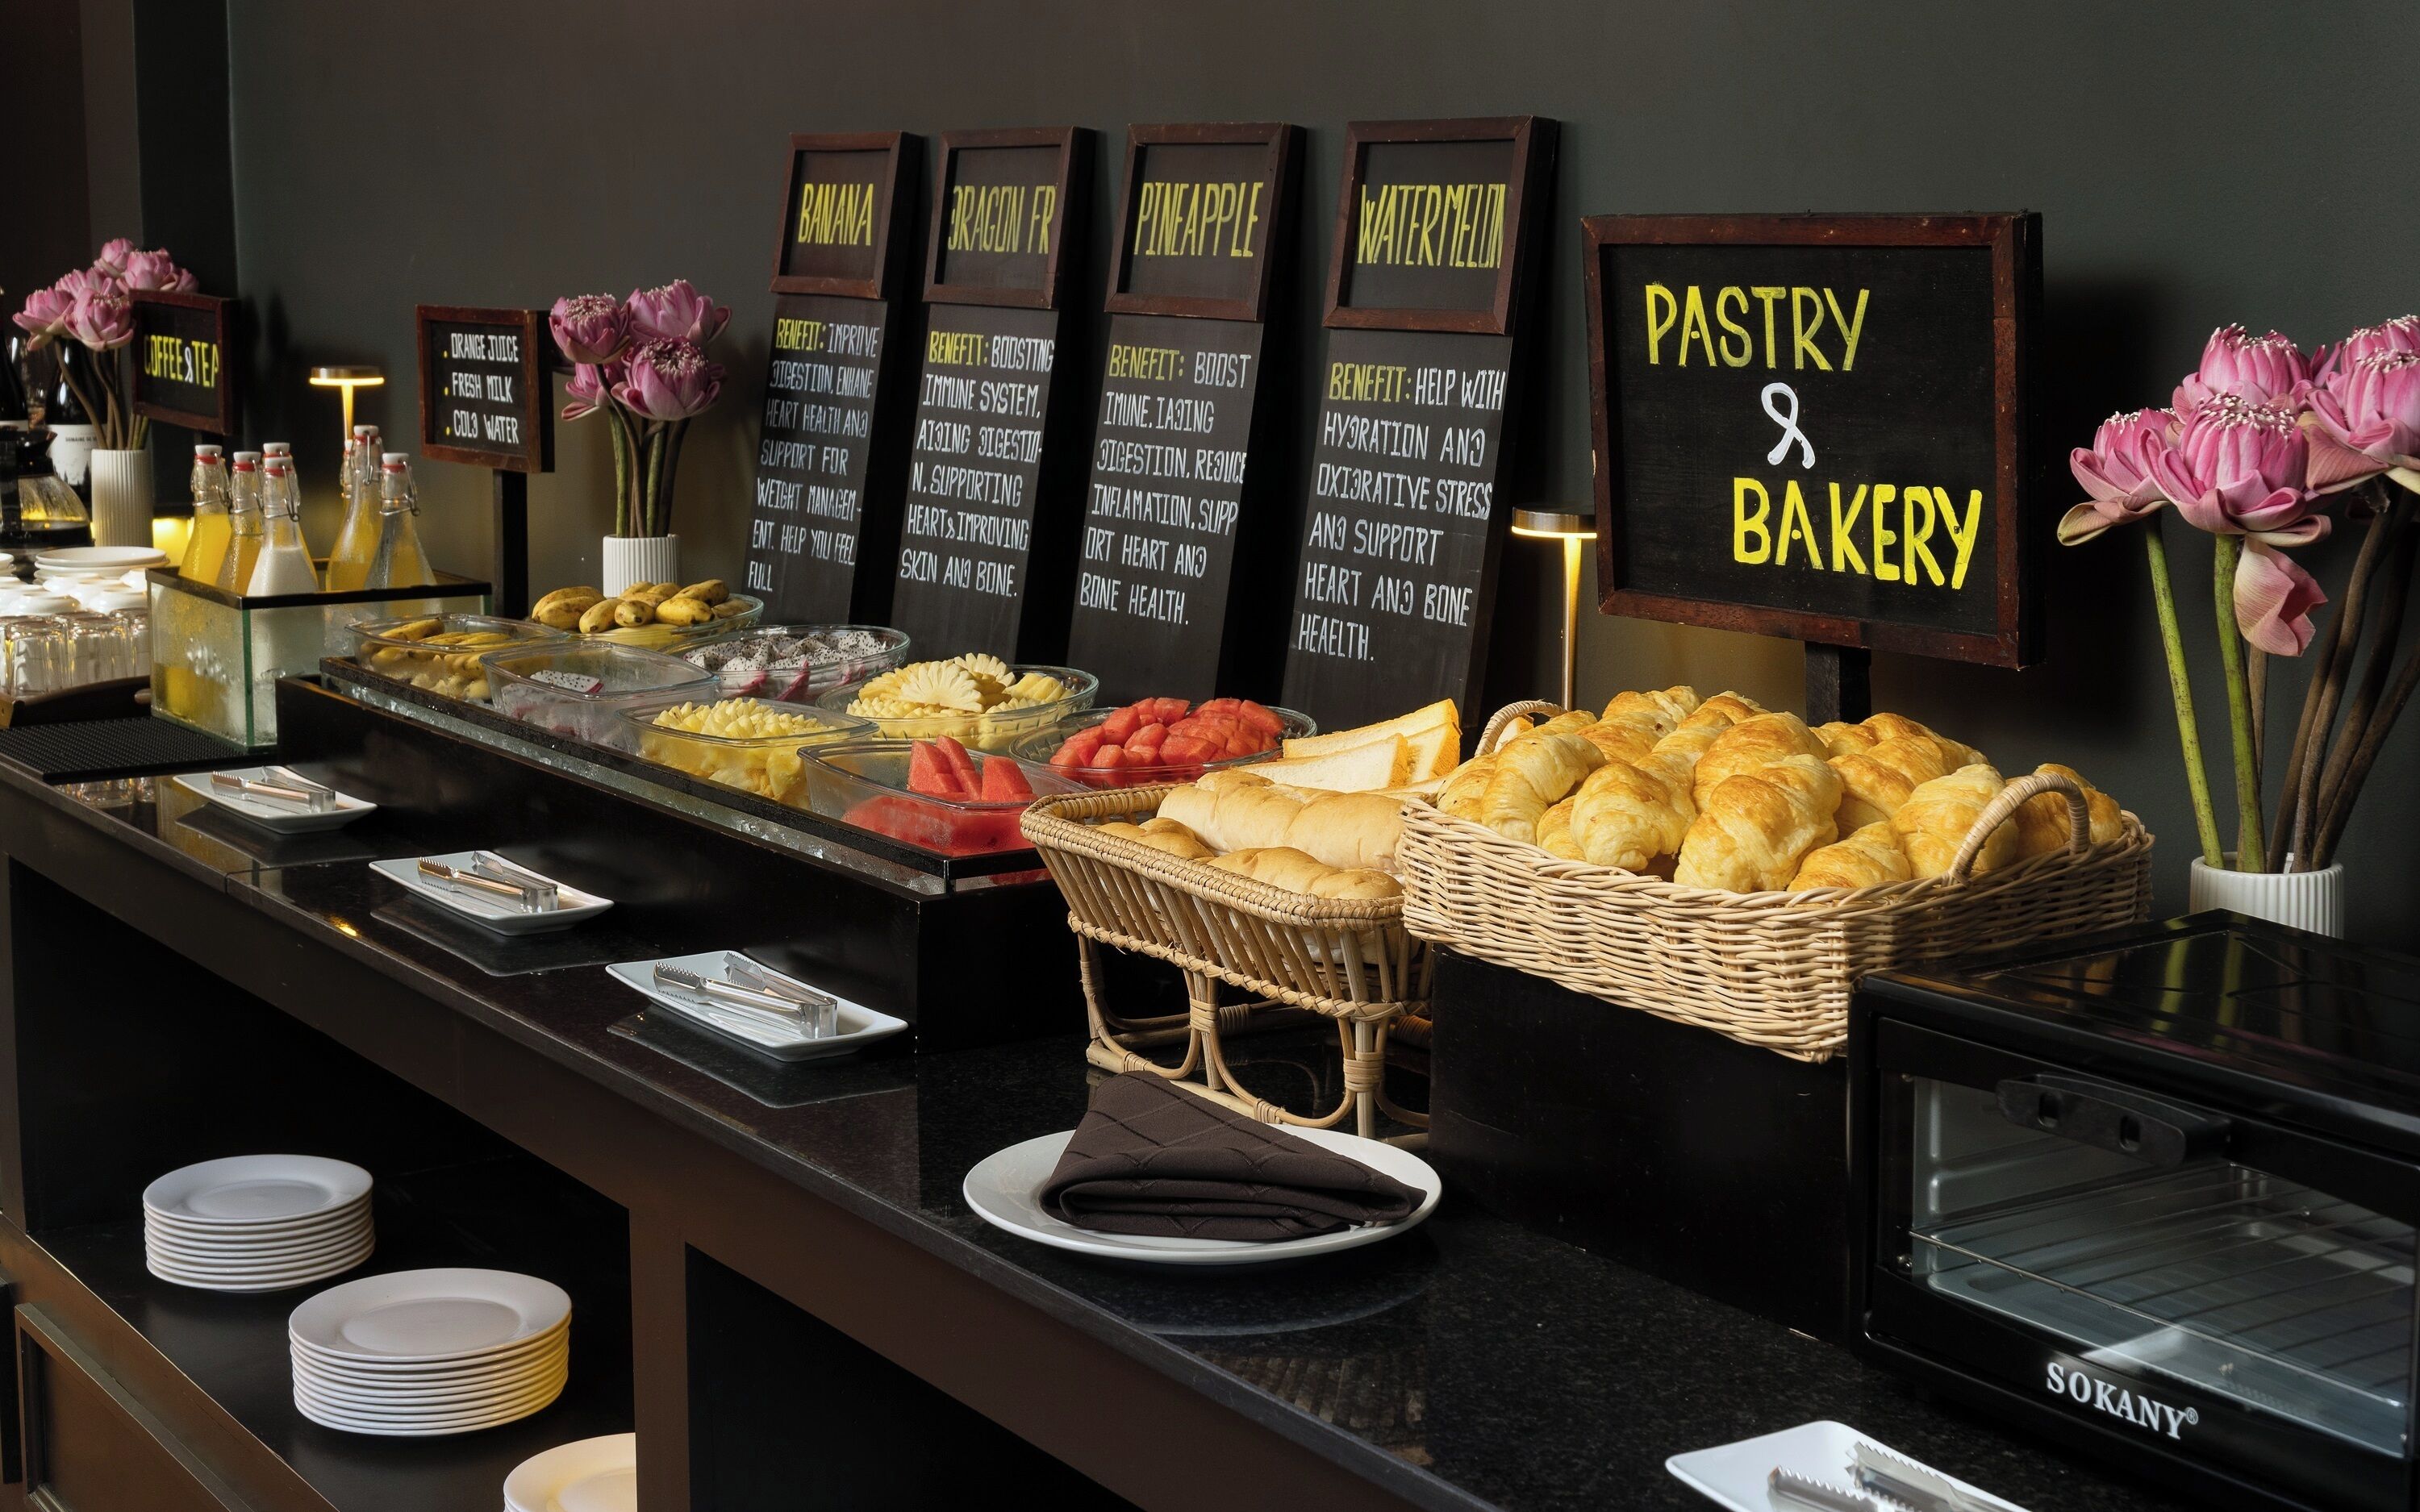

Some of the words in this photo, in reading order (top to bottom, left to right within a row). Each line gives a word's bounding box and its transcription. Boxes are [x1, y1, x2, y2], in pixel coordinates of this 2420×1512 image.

[798, 183, 874, 245] BANANA
[1134, 181, 1263, 257] PINEAPPLE
[451, 333, 486, 360] ORANGE
[488, 335, 519, 362] JUICE
[775, 318, 826, 351] BENEFIT:
[828, 323, 880, 357] IMPROVE
[928, 331, 989, 366] BENEFIT:
[1645, 283, 1870, 371] PASTRY
[452, 372, 482, 398] FRESH
[486, 375, 513, 403] MILK
[1109, 344, 1184, 381] BENEFIT:
[1194, 352, 1251, 388] BOOST
[1329, 362, 1412, 402] BENEFIT:
[1415, 368, 1456, 406] HELP
[1461, 369, 1506, 410] WITH
[766, 398, 799, 429] HEART
[803, 402, 841, 434] HEALTH
[923, 373, 976, 411] IMMUNE
[980, 381, 1040, 419] SYSTEM,
[483, 414, 519, 444] WATER
[1324, 410, 1429, 460] HYDRATION
[761, 439, 816, 470] SUPPORT
[822, 446, 849, 476] FOR
[757, 477, 803, 511] WEIGHT
[930, 464, 1023, 507] SUPPORTING
[1435, 479, 1492, 520] STRESS
[1198, 498, 1239, 535] SUPP
[1734, 477, 1983, 589] BAKERY
[780, 524, 807, 554] HELP
[811, 529, 832, 560] YOU
[834, 533, 855, 565] FEEL
[1085, 527, 1115, 561] ORT
[1121, 534, 1169, 571] HEART
[1354, 519, 1444, 566] SUPPORT
[749, 561, 773, 592] FULL
[900, 548, 937, 583] SKIN
[976, 560, 1017, 597] BONE.
[1304, 561, 1362, 606] HEART
[1423, 584, 1472, 627] BONE
[1080, 572, 1121, 611] BONE
[1129, 584, 1188, 625] HEALTH.
